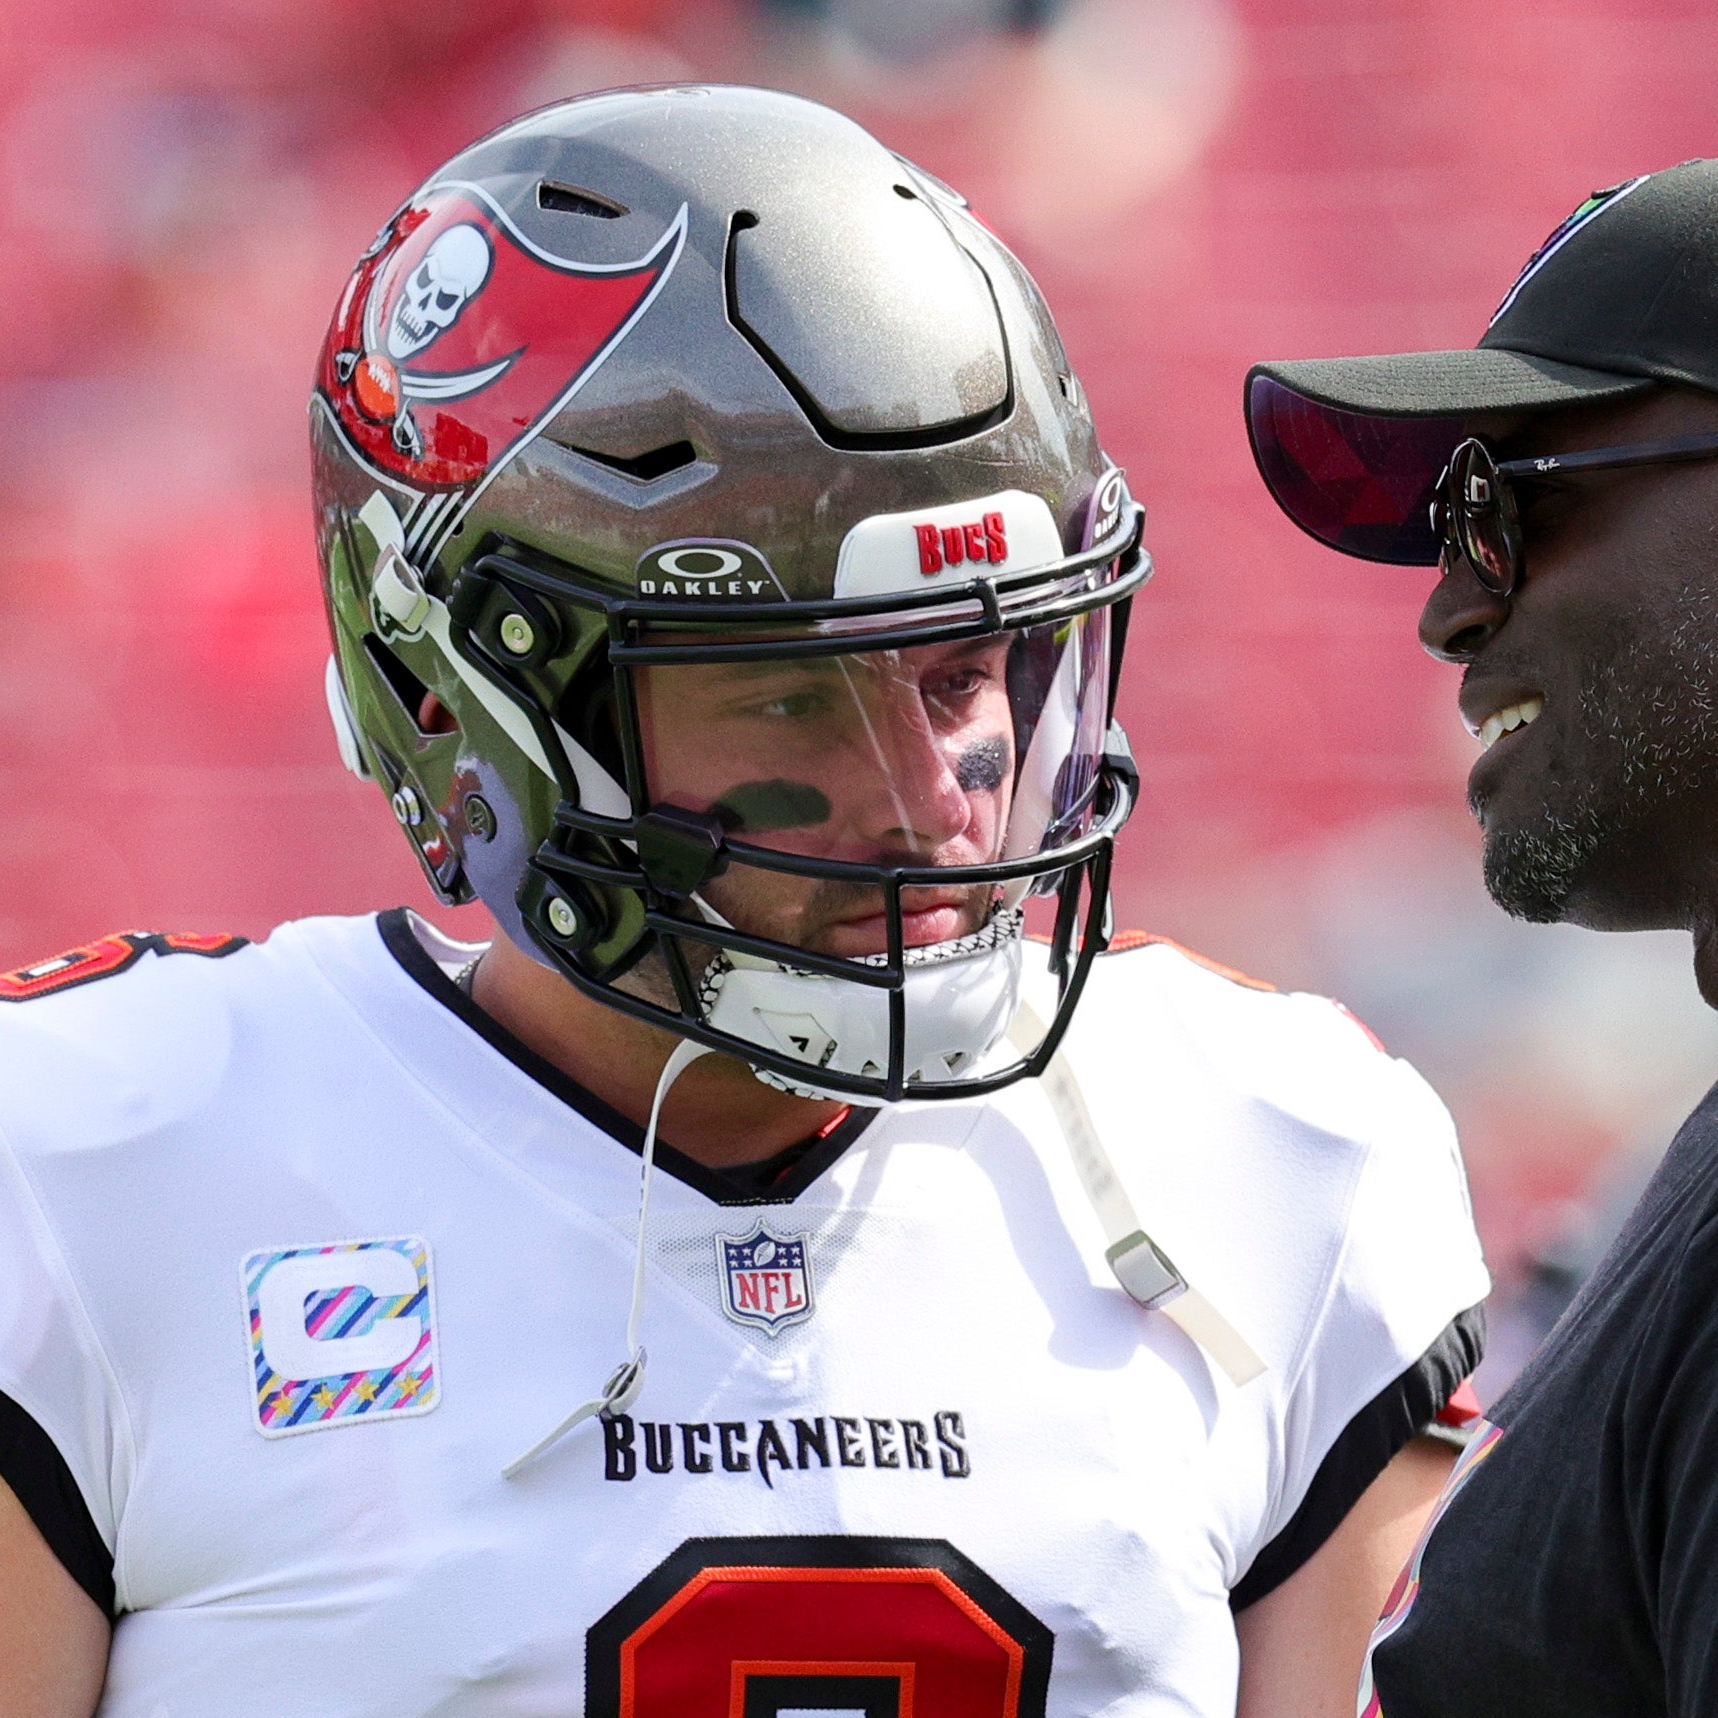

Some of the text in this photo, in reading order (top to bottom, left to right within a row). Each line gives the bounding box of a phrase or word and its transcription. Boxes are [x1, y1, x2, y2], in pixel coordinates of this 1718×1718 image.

[913, 511, 1008, 575] BUCS
[640, 580, 763, 595] OAKLEY
[736, 1272, 803, 1314] NFL
[602, 1410, 971, 1489] BUCCANEERS
